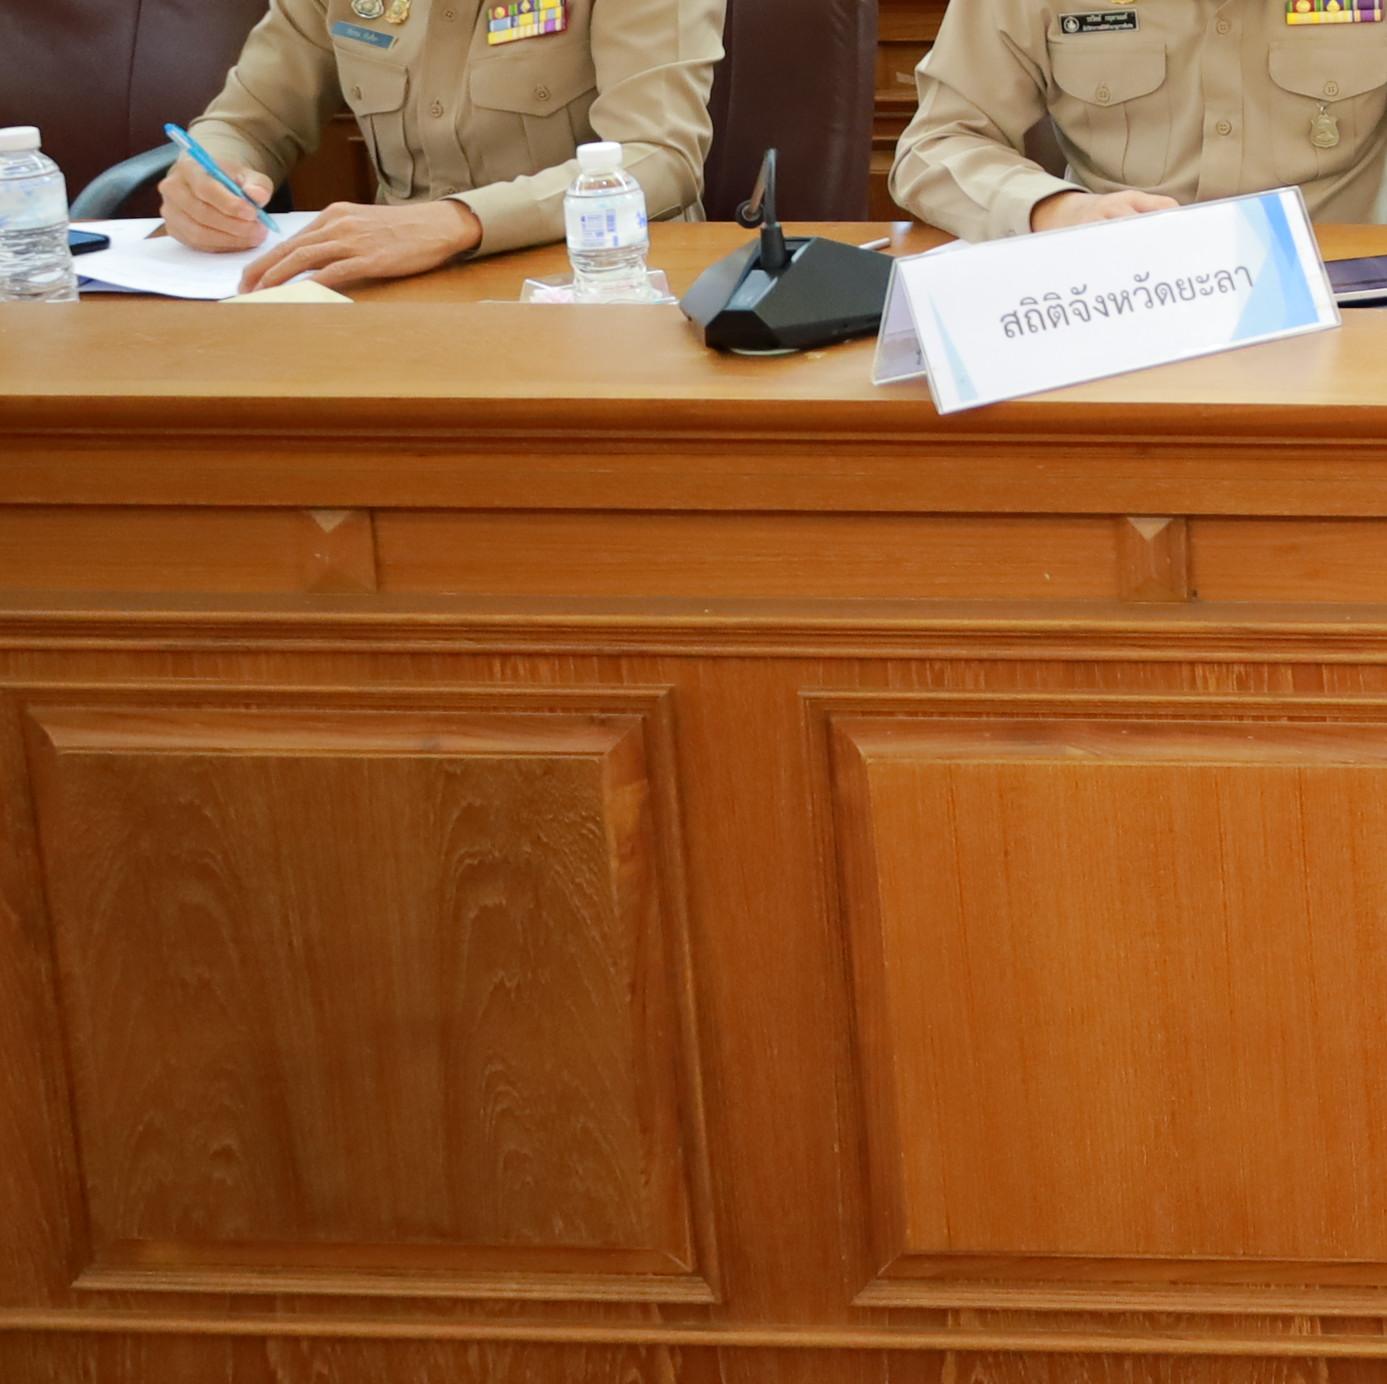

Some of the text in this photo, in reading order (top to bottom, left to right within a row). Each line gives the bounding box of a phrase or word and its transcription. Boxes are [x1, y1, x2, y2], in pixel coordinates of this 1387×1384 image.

[999, 259, 1255, 341] สถิติจังหวัดยะลา
